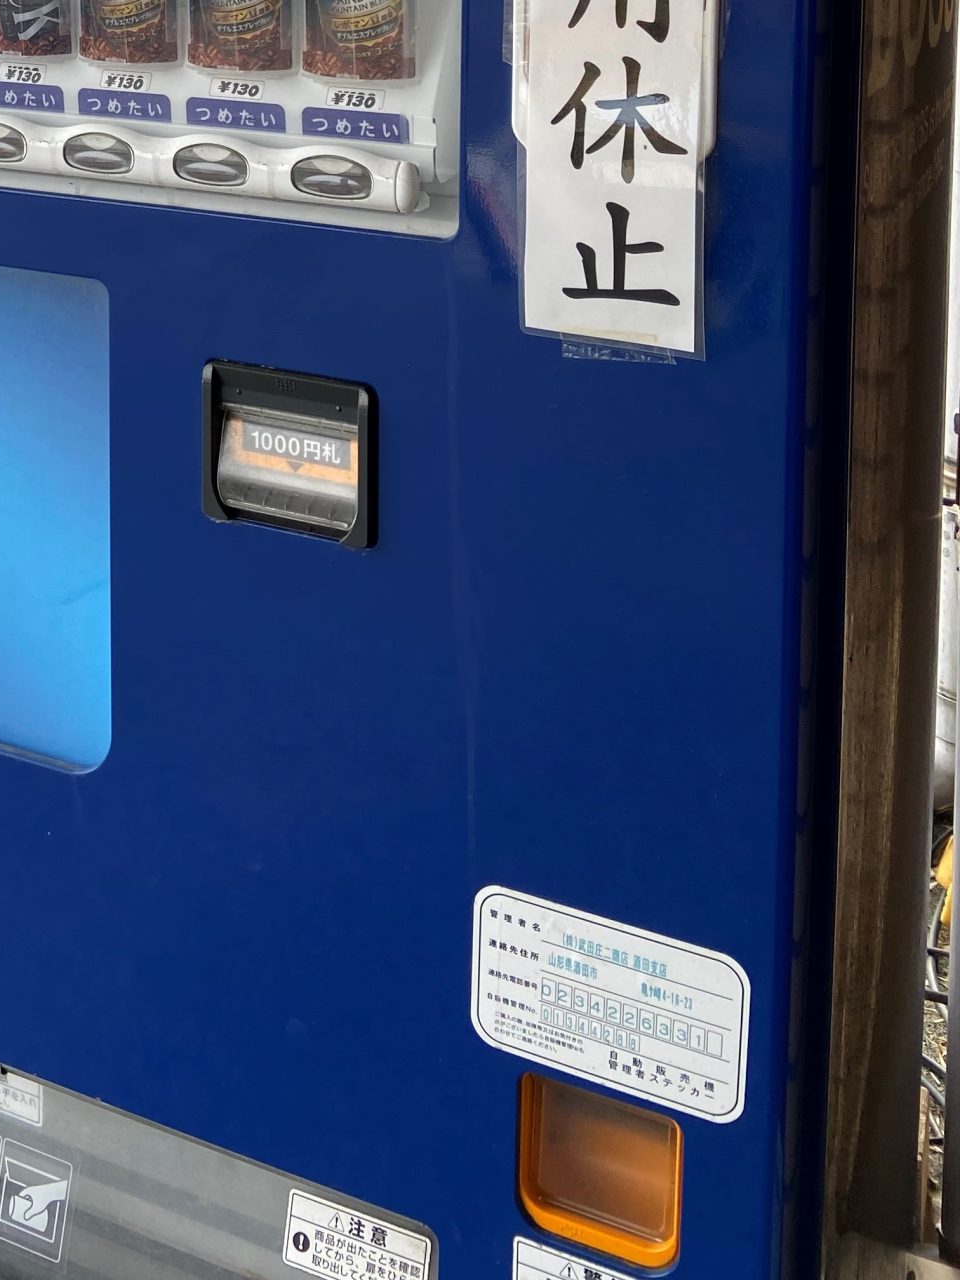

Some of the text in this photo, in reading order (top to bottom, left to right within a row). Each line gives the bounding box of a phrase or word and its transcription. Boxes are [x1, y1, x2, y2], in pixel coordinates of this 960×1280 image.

[4, 69, 41, 83] ¥130
[104, 75, 143, 91] ¥130
[217, 80, 260, 97] ¥130
[87, 97, 162, 116] つめたい
[331, 93, 376, 109] ¥130
[195, 106, 276, 126] つめたい
[311, 116, 399, 139] つめたい
[251, 431, 341, 464] 1000円札
[488, 938, 539, 962] 連絡先住所
[548, 951, 598, 980] 山形県酒田市
[488, 968, 538, 991] 連絡先電話番号
[608, 1060, 715, 1099] 管理者ステッカー
[610, 1050, 715, 1093] 自動販売機
[348, 1216, 389, 1248] 注意
[314, 1228, 422, 1279] 商品が出たことを確認
